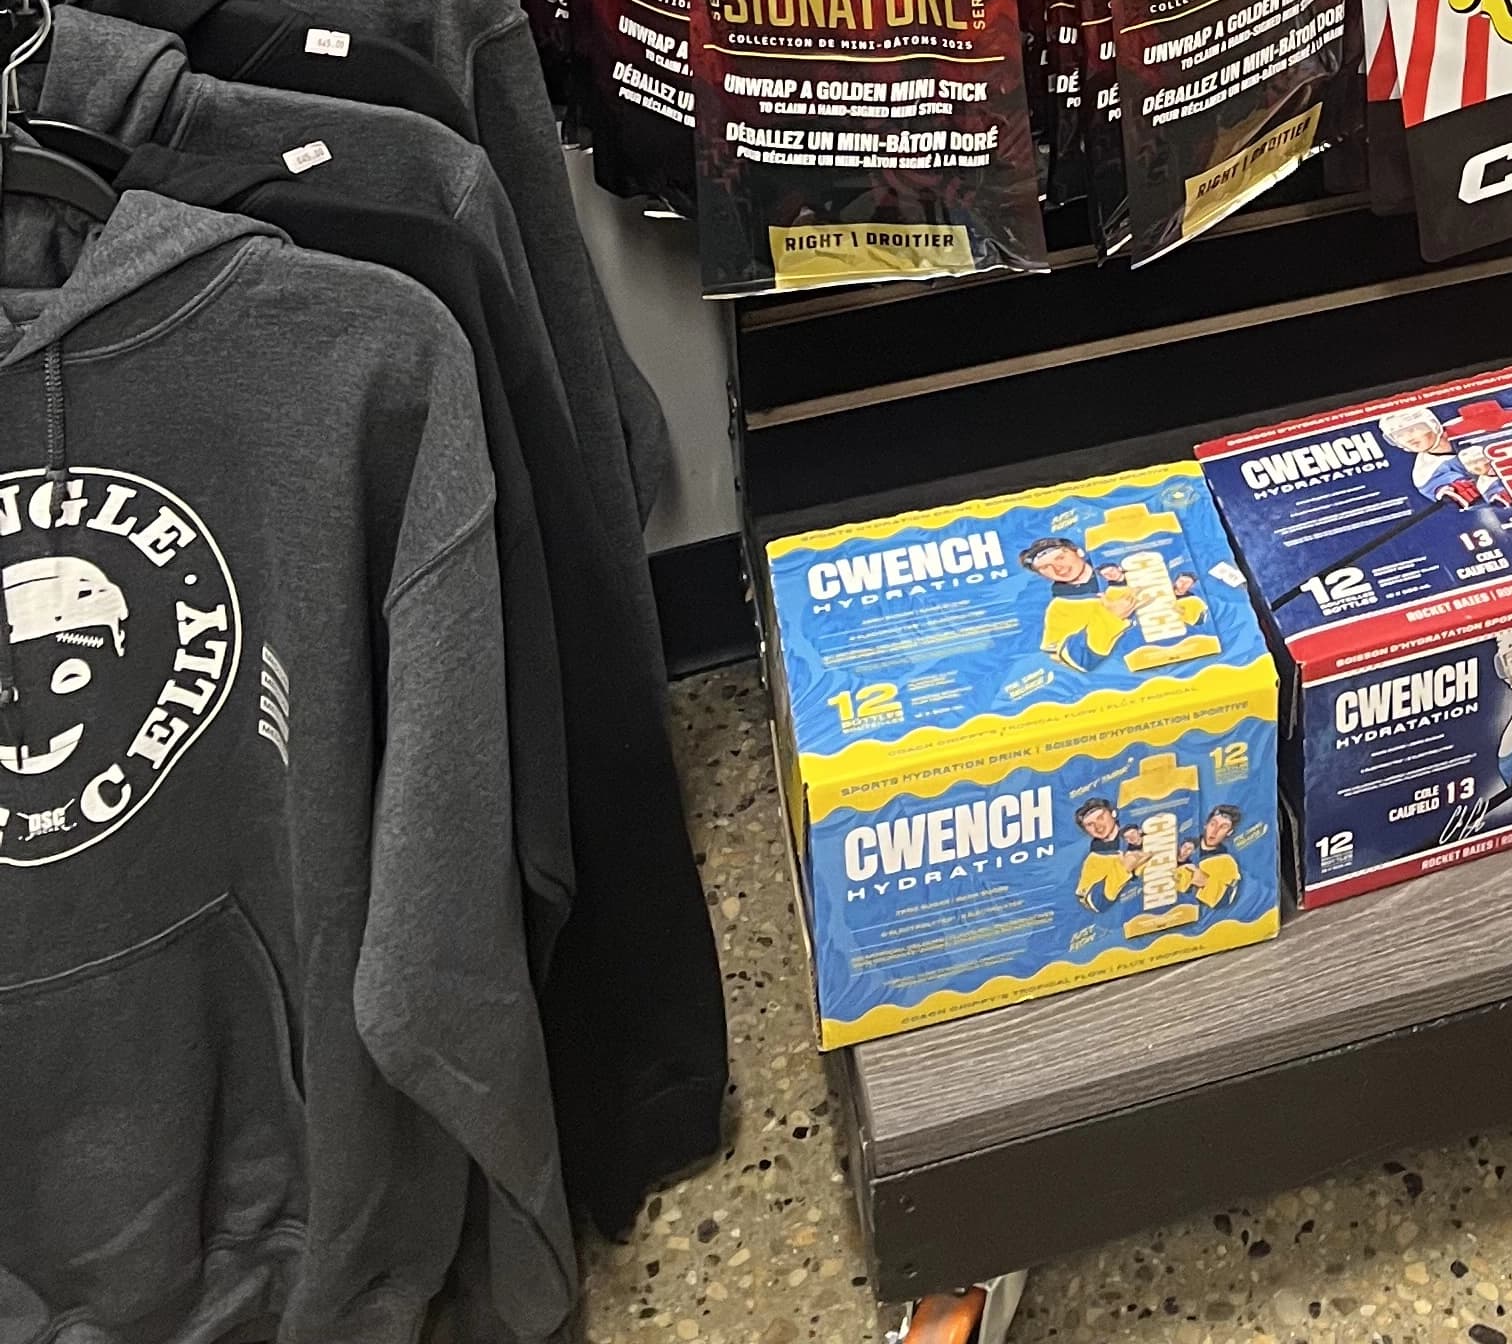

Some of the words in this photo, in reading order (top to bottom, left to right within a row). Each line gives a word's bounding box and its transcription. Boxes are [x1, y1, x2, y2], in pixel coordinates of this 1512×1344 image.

[723, 73, 797, 101] UNWRAP
[800, 80, 813, 101] A
[816, 80, 887, 103] GOLDEN
[890, 78, 936, 102] MINI
[937, 78, 989, 103] STICK
[726, 120, 804, 150] DÉBALLEZ
[808, 130, 832, 150] UN
[837, 127, 947, 153] MINI-BÂTON
[948, 126, 999, 151] DORÉ
[784, 232, 844, 252] RIGHT
[865, 231, 955, 248] DROITIER
[1240, 431, 1385, 492] CWENCH
[1254, 460, 1390, 502] HYDRATATION
[1459, 530, 1493, 553] 13
[1475, 548, 1504, 565] COLE
[806, 530, 1004, 602] CWENCH
[1456, 556, 1510, 582] CAUFIELD
[813, 568, 1009, 615] HYDRATION
[1300, 567, 1373, 603] 12
[1336, 650, 1388, 668] BOISSON
[1389, 622, 1483, 657] D'HYDRATATION
[828, 683, 902, 720] 12
[1335, 657, 1479, 734] CWENCH
[1336, 702, 1479, 750] HYDRATATION
[1209, 741, 1249, 769] 12
[1414, 784, 1440, 801] COLE
[1446, 776, 1476, 805] 13
[1388, 797, 1440, 824] CAUFIELD
[844, 785, 1054, 882] CWENCH
[1315, 830, 1354, 858] 12
[847, 844, 1056, 902] HYDRATION
[1143, 812, 1179, 911] CWENCH
[1421, 849, 1461, 871] ROCKET
[1463, 839, 1494, 860] BAIES
